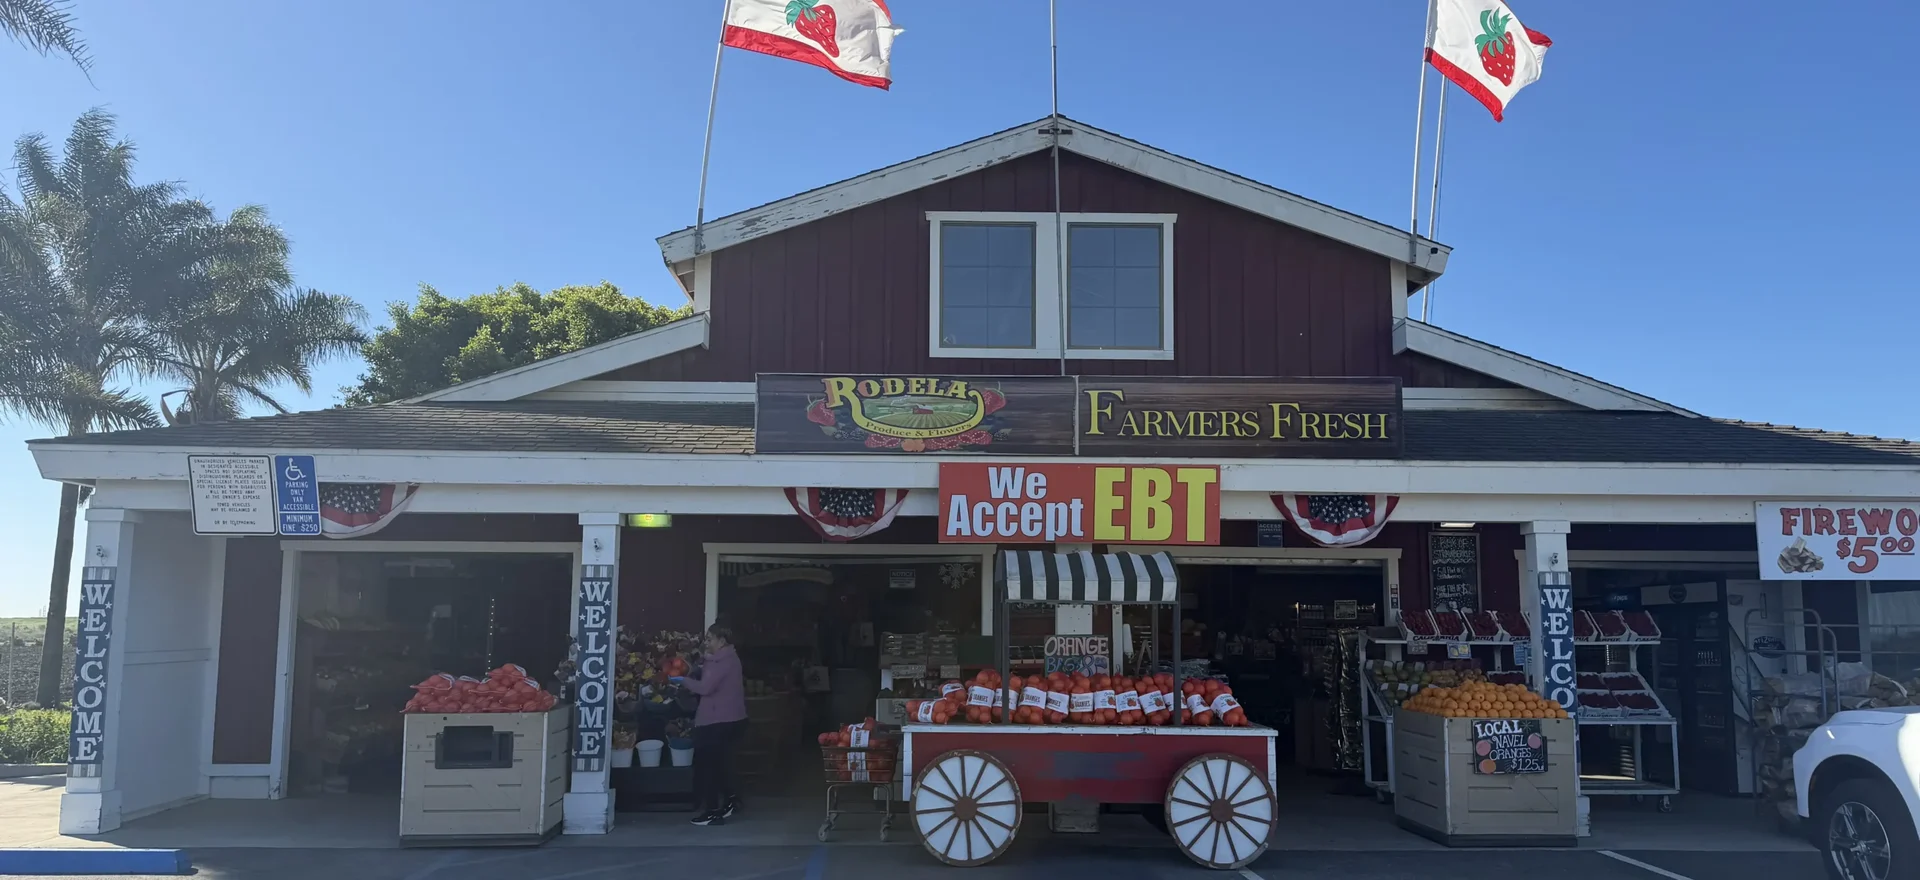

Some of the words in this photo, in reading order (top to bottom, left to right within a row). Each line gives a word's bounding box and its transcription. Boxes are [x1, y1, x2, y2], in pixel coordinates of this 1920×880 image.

[823, 377, 968, 408] RODELA
[866, 421, 912, 437] Produce
[914, 429, 924, 437] &
[927, 422, 973, 437] Flowers
[1084, 389, 1261, 437] FARMERS
[1268, 402, 1389, 439] FRESH
[988, 466, 1048, 500] We
[946, 494, 1084, 542] Accept
[1093, 466, 1218, 542] EBT
[300, 524, 318, 532] $250
[1779, 507, 1920, 536] FIREWO
[1044, 636, 1109, 656] ORANGE
[74, 583, 112, 761] WELCOME
[578, 581, 610, 756] WELCOME
[1475, 720, 1523, 738] LOCAL
[1492, 734, 1527, 749] NAVEL
[1489, 748, 1532, 761] ORANGES
